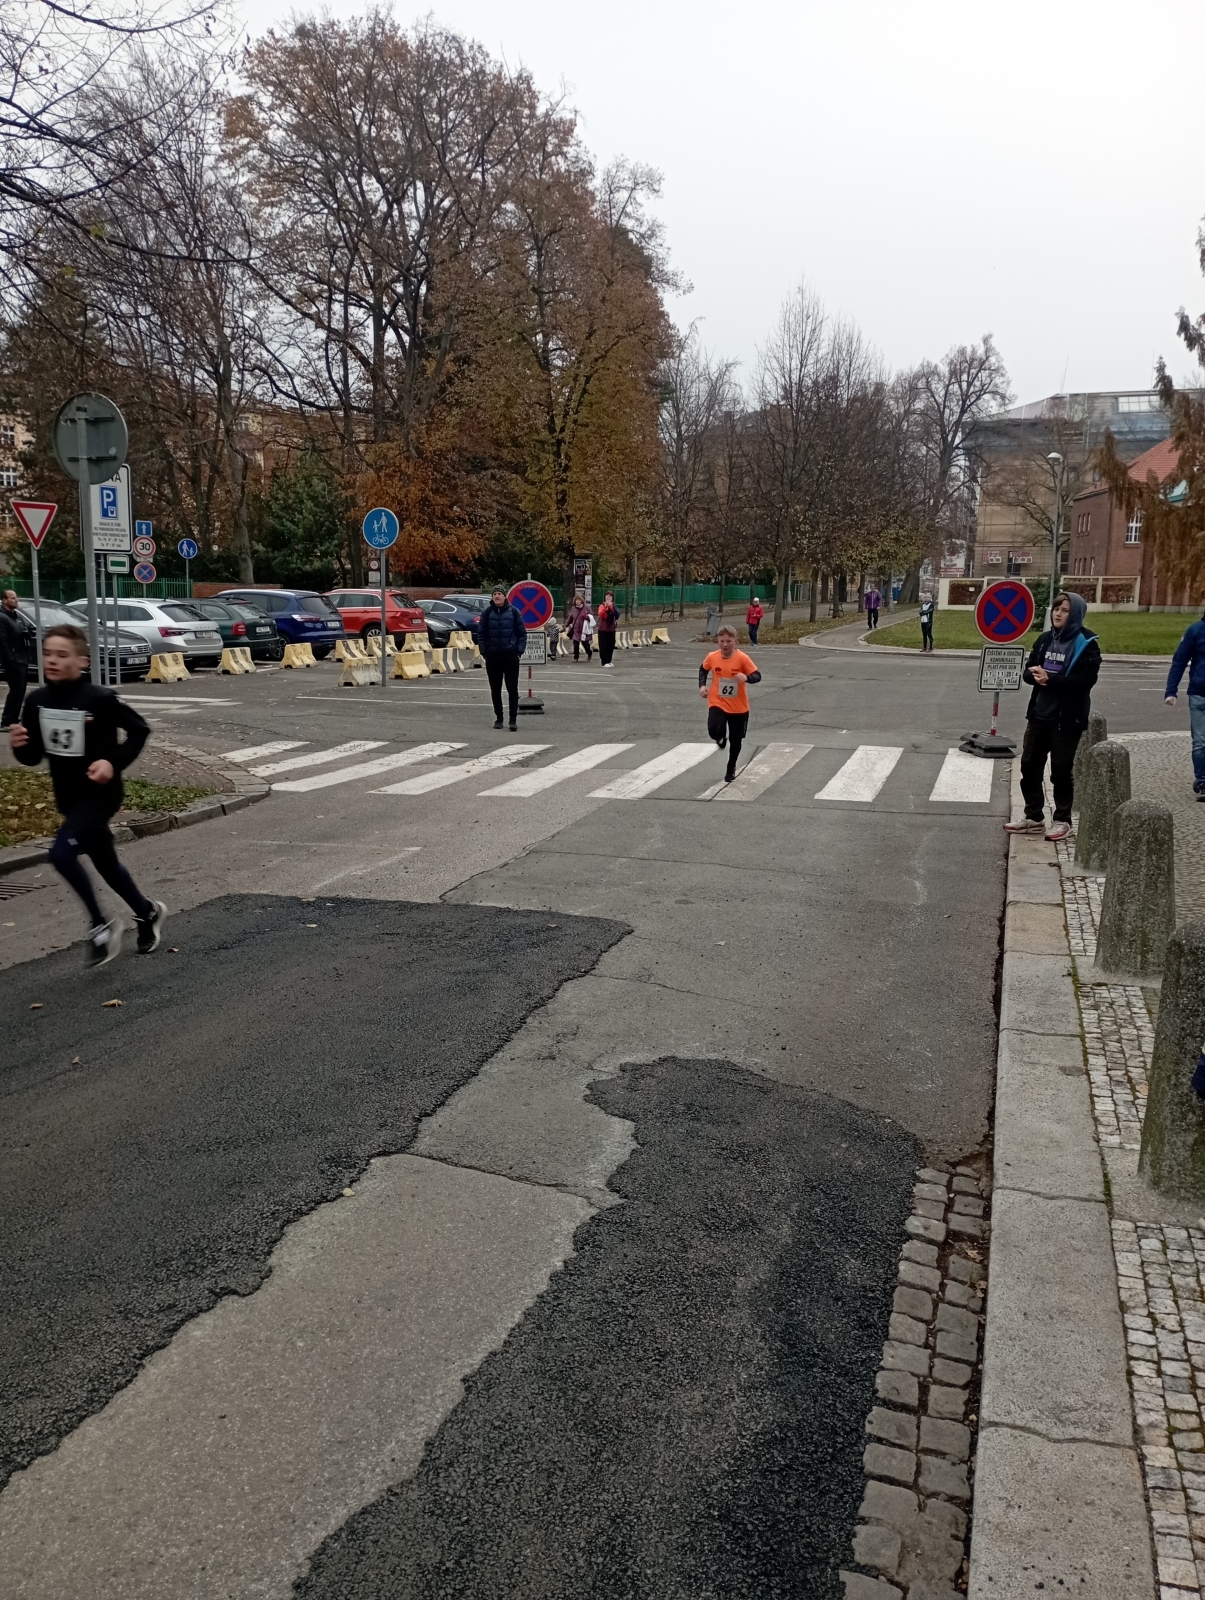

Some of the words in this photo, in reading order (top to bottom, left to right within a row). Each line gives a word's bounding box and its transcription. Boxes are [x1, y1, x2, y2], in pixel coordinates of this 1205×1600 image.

[102, 489, 114, 509] P
[138, 542, 151, 551] 30
[722, 685, 734, 695] 62
